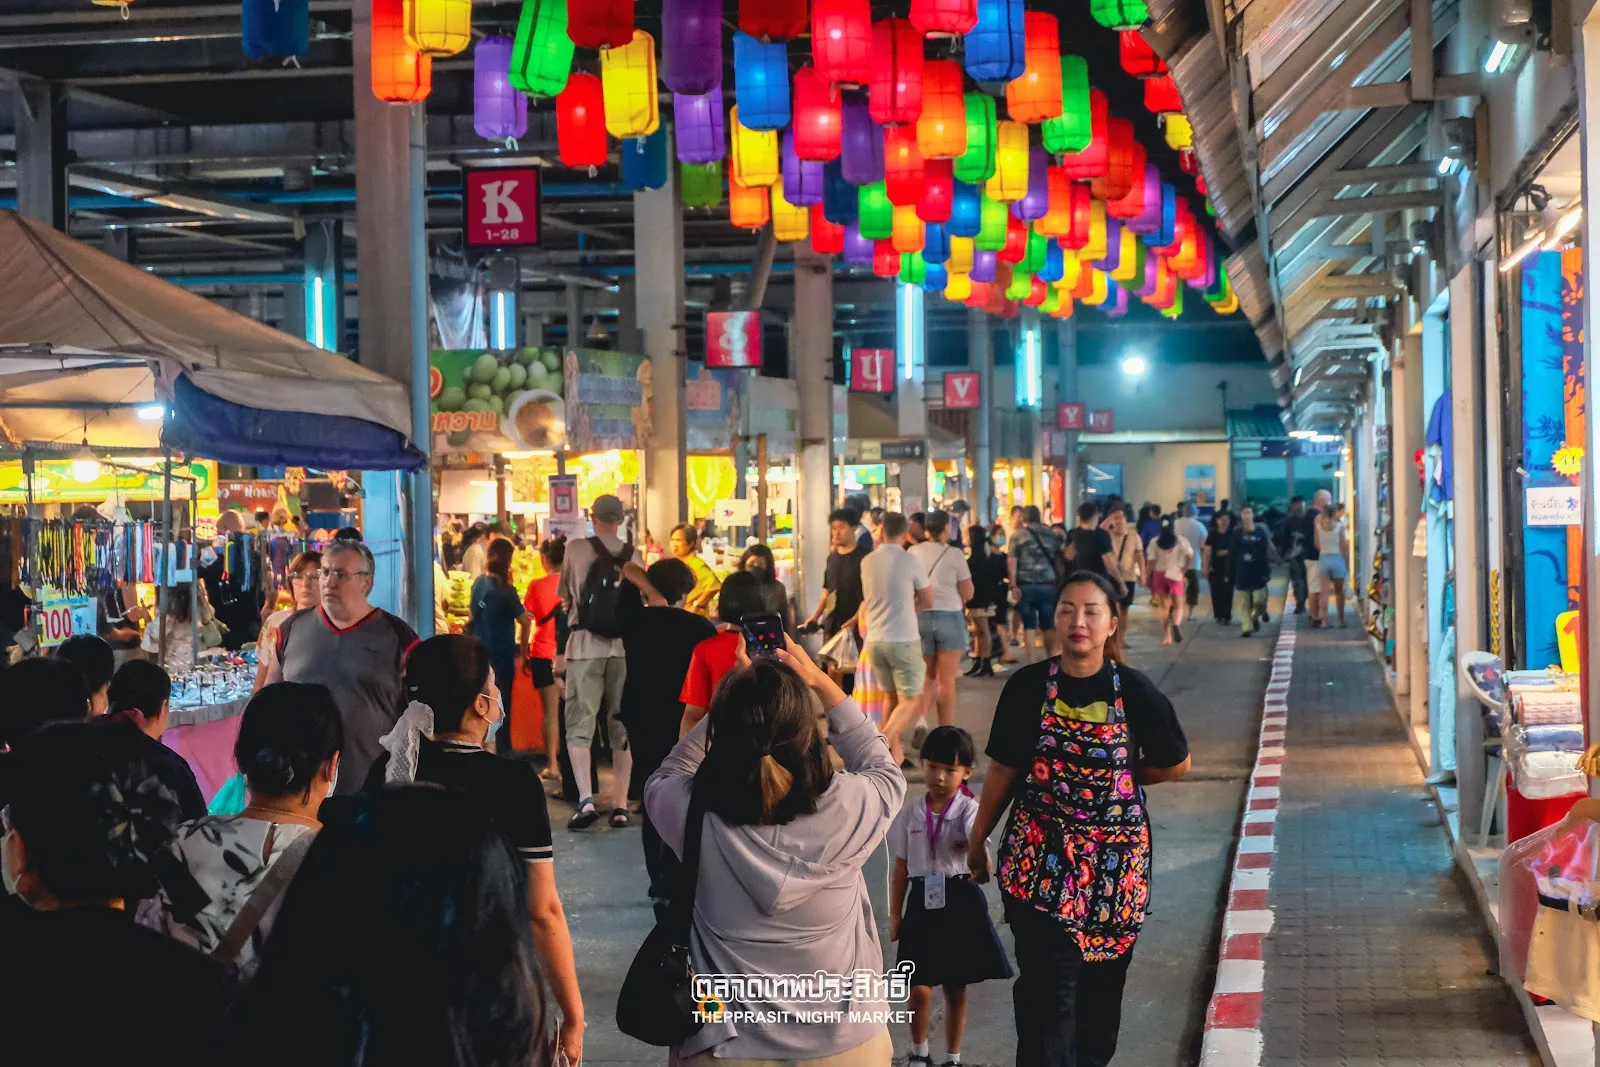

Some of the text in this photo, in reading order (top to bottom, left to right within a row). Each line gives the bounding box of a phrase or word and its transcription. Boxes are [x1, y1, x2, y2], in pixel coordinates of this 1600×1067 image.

[481, 180, 524, 224] K
[485, 228, 519, 240] 1-28
[952, 377, 973, 398] V
[1064, 407, 1080, 424] Y
[41, 607, 73, 640] 100
